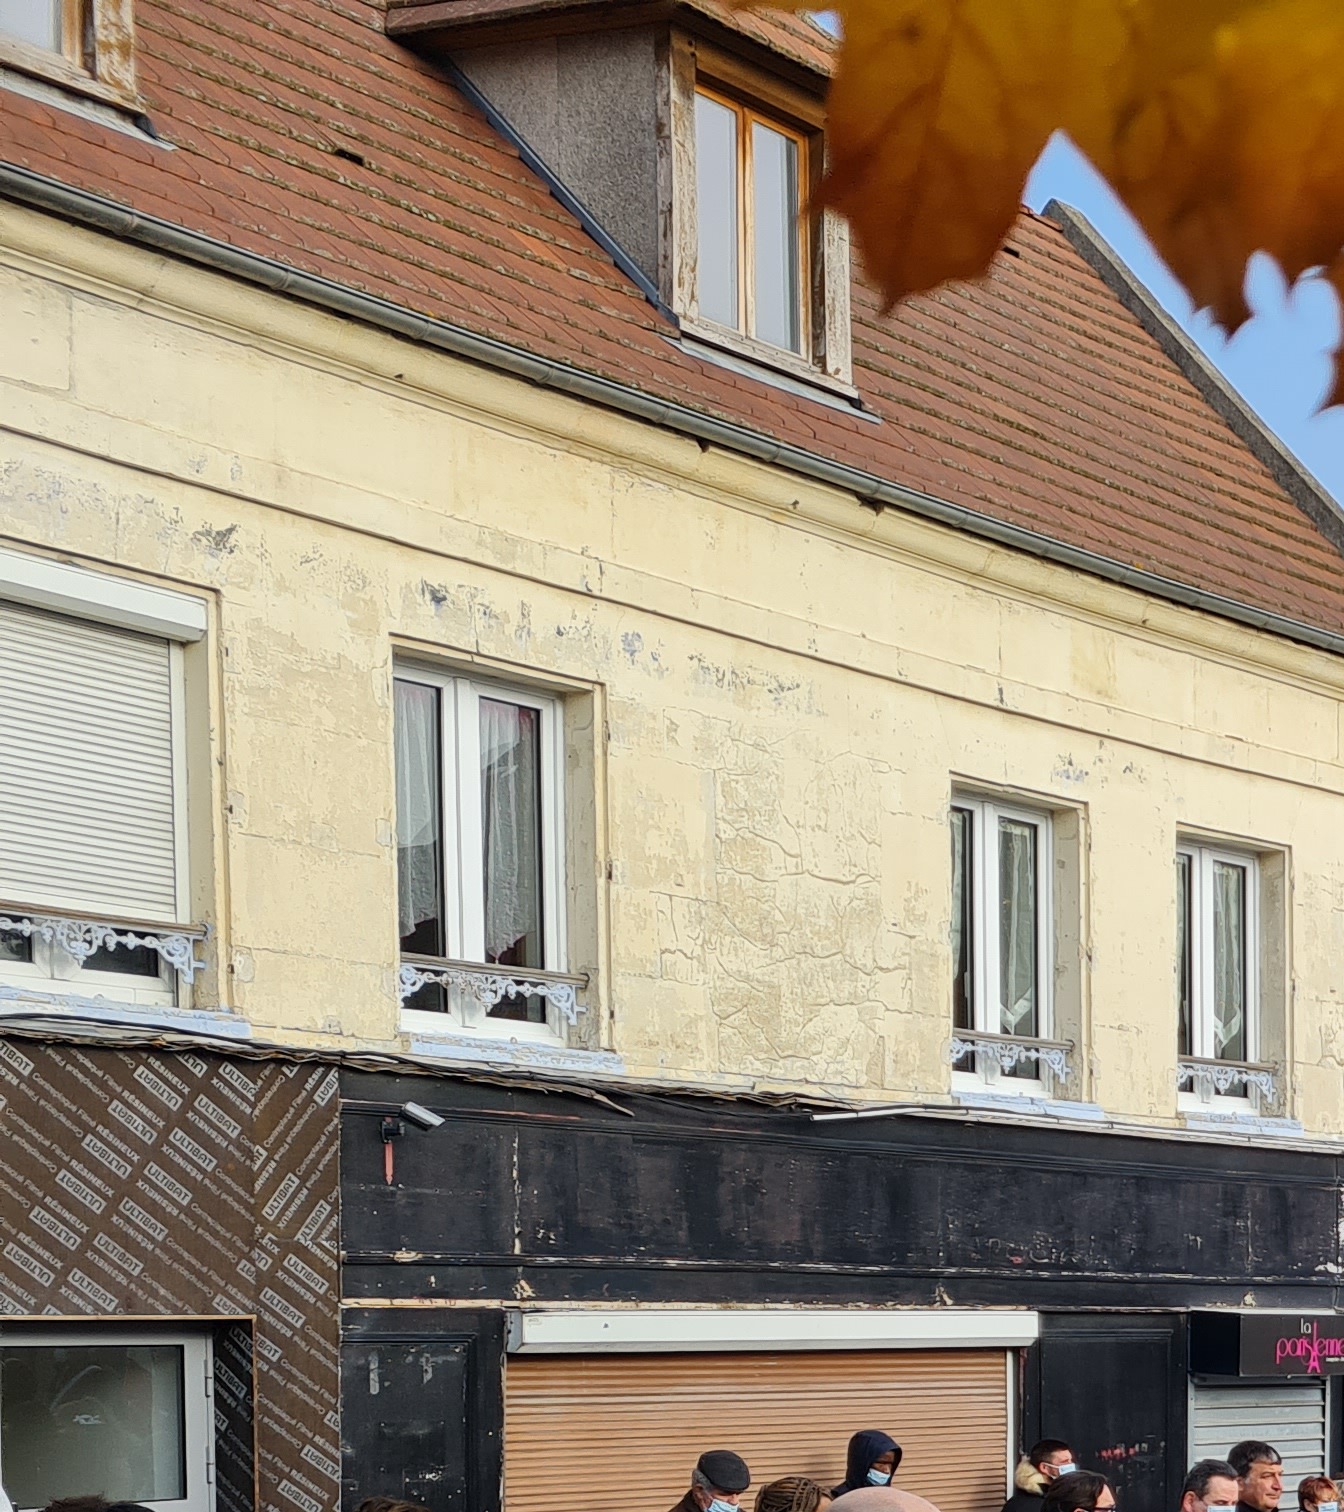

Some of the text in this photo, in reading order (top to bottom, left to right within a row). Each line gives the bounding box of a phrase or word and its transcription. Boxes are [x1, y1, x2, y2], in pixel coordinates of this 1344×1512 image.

[136, 1069, 181, 1107] ULTIBAT
[109, 1101, 156, 1141] ULTIBAT
[195, 1097, 239, 1134] ULTIBAT
[84, 1138, 130, 1177] ULTIBAT
[170, 1131, 214, 1168] ULTIBAT
[58, 1173, 103, 1211] ULTIBAT
[146, 1164, 190, 1201] ULTIBAT
[263, 1175, 298, 1217] ULTIBAT
[32, 1208, 78, 1248] ULTIBAT
[121, 1200, 165, 1237] ULTIBAT
[5, 1244, 52, 1284] ULTIBAT
[96, 1235, 140, 1272] ULTIBAT
[70, 1270, 115, 1308] ULTIBAT
[285, 1256, 327, 1291] ULTIBAT
[261, 1290, 303, 1325] ULTIBAT
[1300, 1318, 1312, 1334] la
